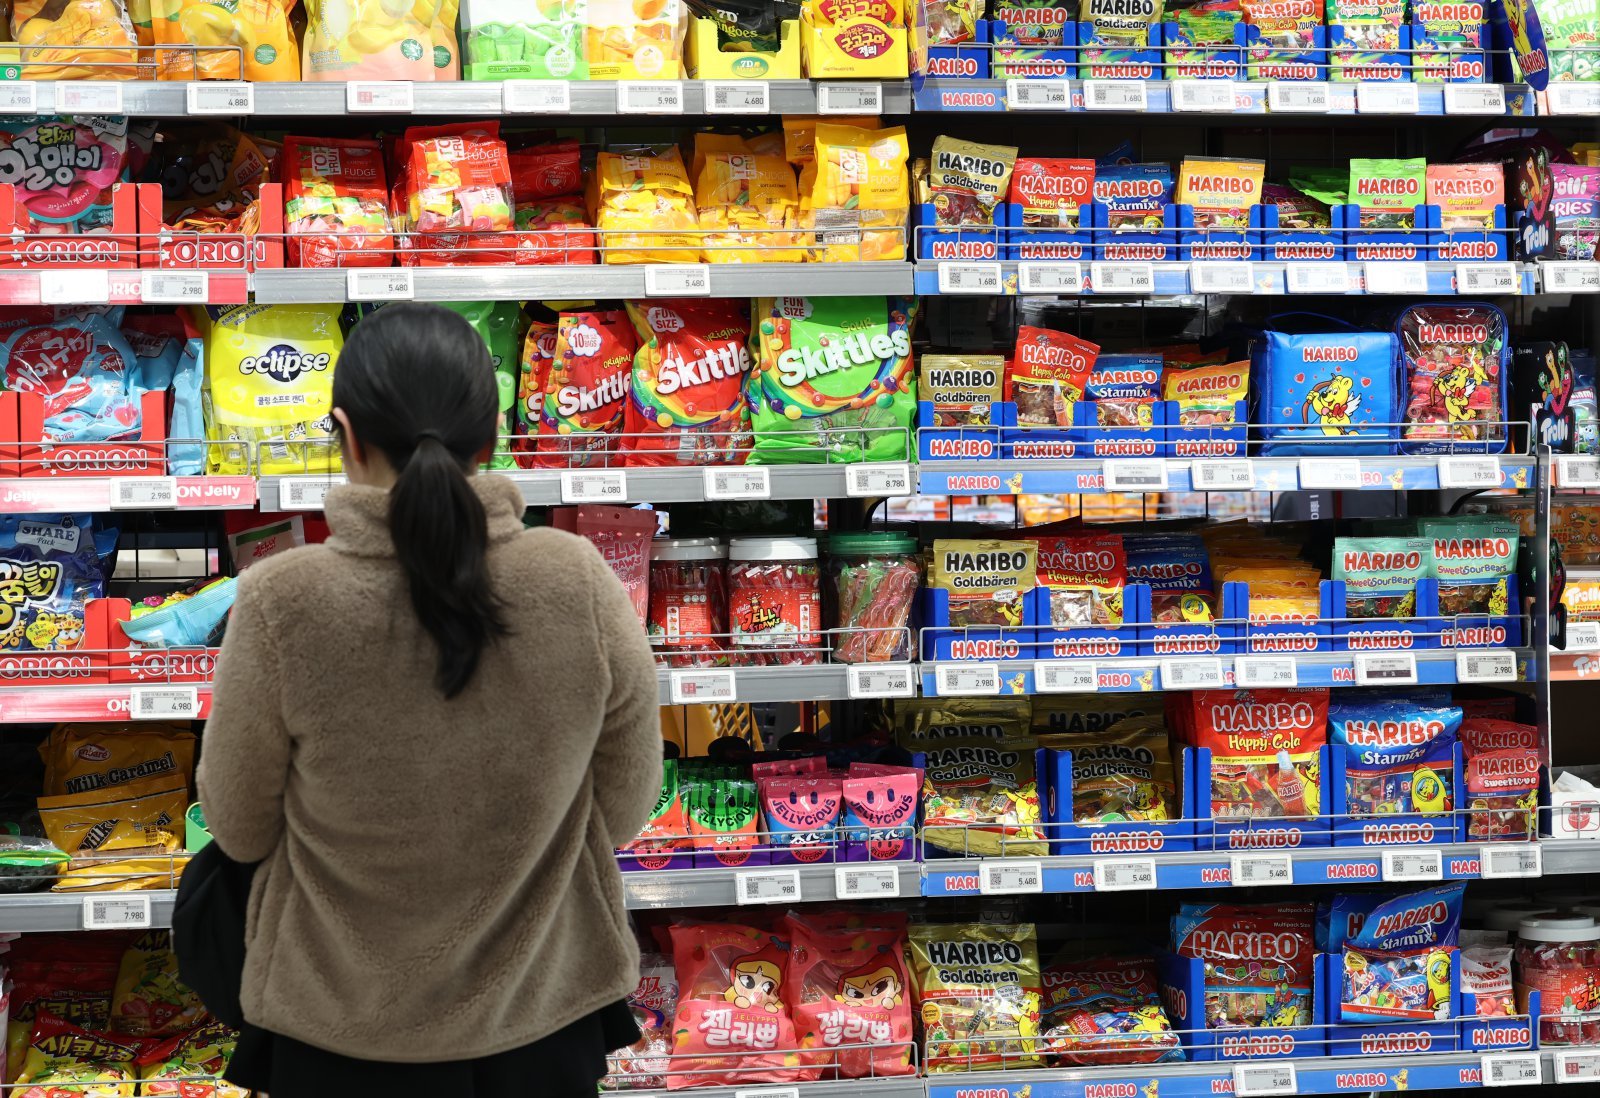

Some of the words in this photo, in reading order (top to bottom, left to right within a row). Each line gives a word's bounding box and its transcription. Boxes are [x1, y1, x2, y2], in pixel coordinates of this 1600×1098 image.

[716, 9, 738, 23] 7D
[1000, 8, 1067, 25] HARIBO
[1090, 0, 1155, 15] HARIBO
[1418, 4, 1483, 21] HARIBO
[1094, 18, 1147, 29] Goldbears
[840, 33, 887, 52] 군고구마
[858, 44, 877, 57] 젤리
[740, 59, 754, 68] 7D
[1004, 60, 1067, 76] HARIBO
[1091, 61, 1153, 78] HARIBO
[1177, 61, 1238, 77] HARIBO
[1258, 63, 1317, 79] HARIBO
[1342, 63, 1402, 79] HARIBO
[1424, 62, 1484, 78] HARIBO
[942, 93, 996, 107] HARIBO
[91, 118, 108, 129] Pack
[0, 137, 101, 191] 알맹이
[465, 149, 499, 162] FUDGE
[236, 159, 261, 183] SHARE
[344, 167, 376, 177] FUDGE
[938, 152, 1005, 178] HARIBO
[942, 173, 998, 193] Goldbären
[1019, 175, 1088, 196] HARIBO
[1095, 179, 1164, 199] HARIBO
[1188, 175, 1255, 194] HARIBO
[1357, 177, 1419, 195] HARIBO
[1434, 178, 1496, 197] HARIBO
[1105, 199, 1154, 211] Starmix
[1522, 225, 1548, 254] Trolli
[26, 240, 119, 263] ORION
[174, 240, 266, 263] ORION
[932, 241, 997, 259] HARIBO
[1020, 242, 1082, 259] HARIBO
[1104, 243, 1166, 260] HARIBO
[1191, 241, 1252, 259] HARIBO
[1275, 242, 1335, 259] HARIBO
[1356, 243, 1417, 260] HARIBO
[1438, 241, 1498, 259] HARIBO
[783, 297, 805, 308] FUN
[654, 310, 675, 320] FUN
[784, 306, 806, 318] SIZE
[656, 318, 678, 329] SIZE
[572, 332, 584, 347] 10
[1419, 324, 1489, 344] HARIBO
[776, 329, 910, 388] Skittles
[1022, 344, 1087, 373] HARIBO
[1303, 346, 1358, 363] HARIBO
[239, 350, 332, 379] eclipse
[656, 341, 751, 395] Skittle
[930, 369, 997, 388] HARIBO
[1088, 369, 1158, 386] HARIBO
[1176, 374, 1242, 394] HARIBO
[934, 391, 992, 404] Goldbären
[1099, 385, 1151, 399] Starmix
[1541, 417, 1568, 446] Trolli
[930, 440, 994, 457] HARIBO
[1012, 439, 1076, 457] HARIBO
[1094, 439, 1156, 456] HARIBO
[1175, 439, 1237, 456] HARIBO
[55, 449, 148, 472] ORION
[946, 475, 1001, 490] HARIBO
[204, 486, 240, 501] Jelly
[22, 526, 76, 541] SHARE
[37, 537, 56, 547] Pack
[1434, 537, 1511, 559] HARIBO
[945, 551, 1027, 573] HARIBO
[1037, 550, 1116, 573] HARIBO
[1344, 551, 1422, 572] HARIBO
[954, 574, 1017, 588] Goldbären
[742, 604, 783, 631] JELLY
[749, 618, 781, 632] STRAWS
[1154, 635, 1221, 653] HARIBO
[1251, 633, 1319, 652] HARIBO
[1349, 630, 1414, 650] HARIBO
[1441, 627, 1506, 646] HARIBO
[951, 639, 1020, 660] HARIBO
[1053, 638, 1121, 657] HARIBO
[0, 656, 91, 678] ORION
[143, 654, 214, 677] ORIO
[1212, 703, 1315, 732] HARIBO
[1345, 719, 1446, 747] HARIBO
[1467, 730, 1534, 749] HARIBO
[1360, 749, 1426, 766] Starmix
[1477, 755, 1539, 777] HARIBO
[65, 775, 107, 794] Milk
[108, 752, 177, 785] Caramel
[932, 764, 1016, 782] Goldbären
[1072, 763, 1151, 780] Goldbären
[1091, 831, 1164, 852] HARIBO
[1230, 828, 1302, 849] HARIBO
[1363, 823, 1434, 844] HARIBO
[1327, 863, 1378, 879] HARIBO
[782, 886, 795, 894] 980
[881, 881, 894, 890] 980
[1181, 921, 1195, 935] NEW
[1374, 901, 1448, 939] HARIBO
[1191, 931, 1299, 962] HARIBO
[1380, 930, 1433, 950] Starmix
[927, 942, 1021, 966] HARIBO
[938, 968, 1019, 984] Goldbären
[734, 1014, 776, 1024] JELLYPPO
[815, 1008, 893, 1047] 젤리뽀
[698, 1009, 778, 1049] 젤리뽀
[1473, 1027, 1530, 1046] HARIBO
[40, 1035, 135, 1062] 새콤달콤
[1223, 1035, 1295, 1056] HARIBO
[1361, 1032, 1432, 1054] HARIBO
[1336, 1073, 1387, 1089] HARIBO
[1085, 1083, 1137, 1098] HARIBO
